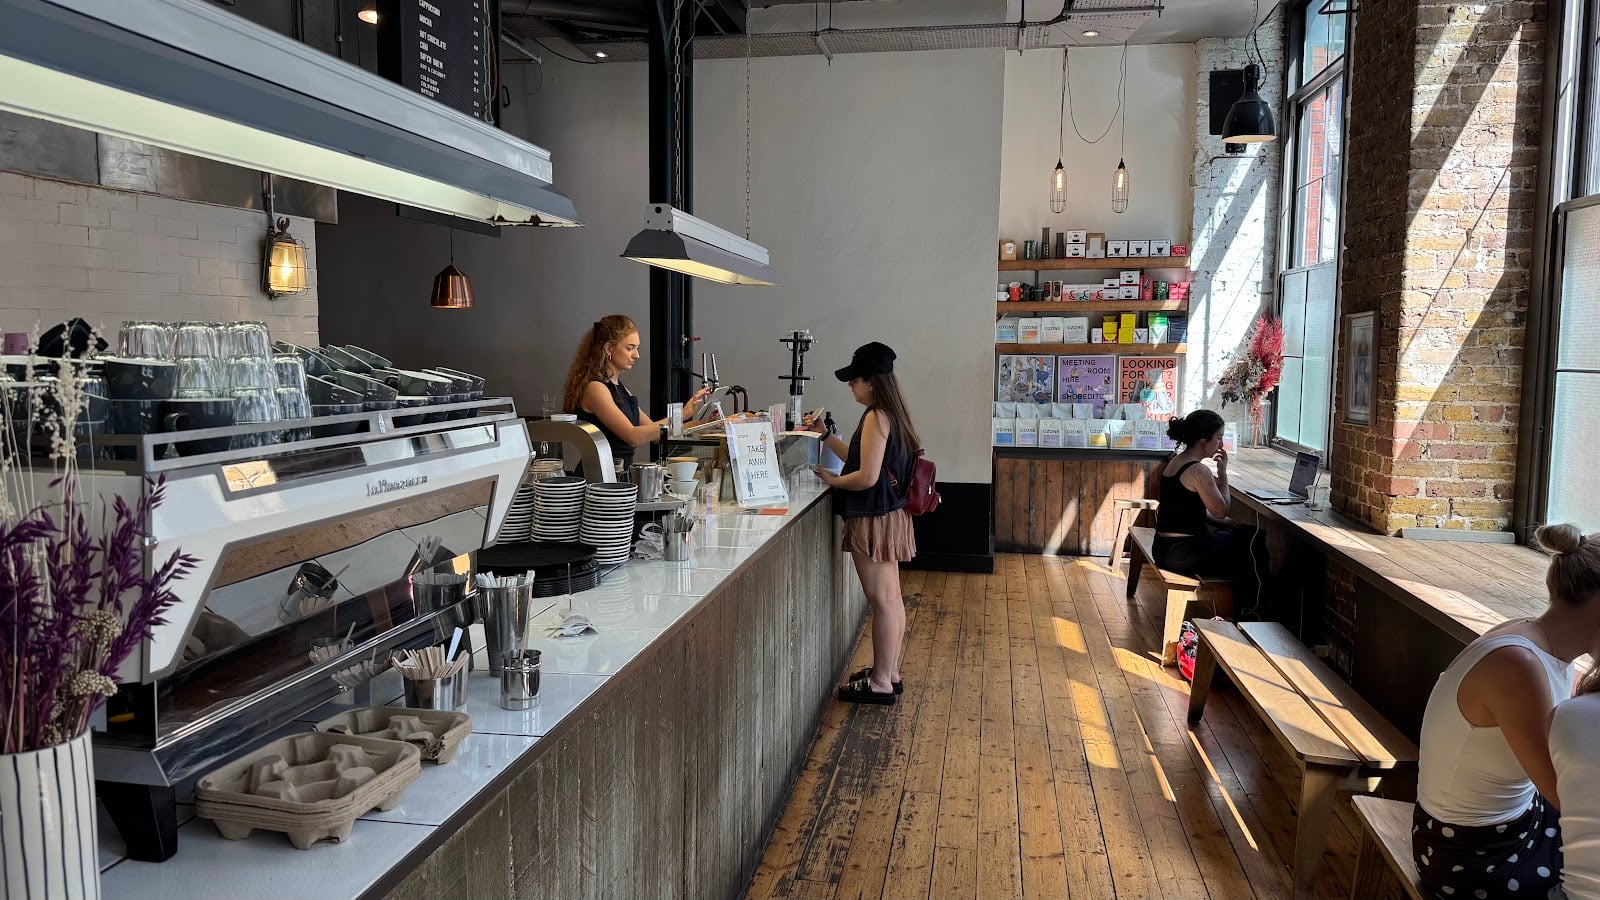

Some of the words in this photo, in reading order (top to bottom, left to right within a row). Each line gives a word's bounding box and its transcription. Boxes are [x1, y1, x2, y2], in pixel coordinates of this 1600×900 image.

[419, 14, 432, 28] MOCHA
[420, 41, 428, 52] CHAI
[427, 34, 446, 51] CHOCOLATE
[1122, 359, 1174, 369] LOOKING
[1122, 370, 1145, 379] FOR
[747, 444, 764, 454] TAKE
[749, 458, 767, 466] AWAY
[751, 471, 769, 480] HERE
